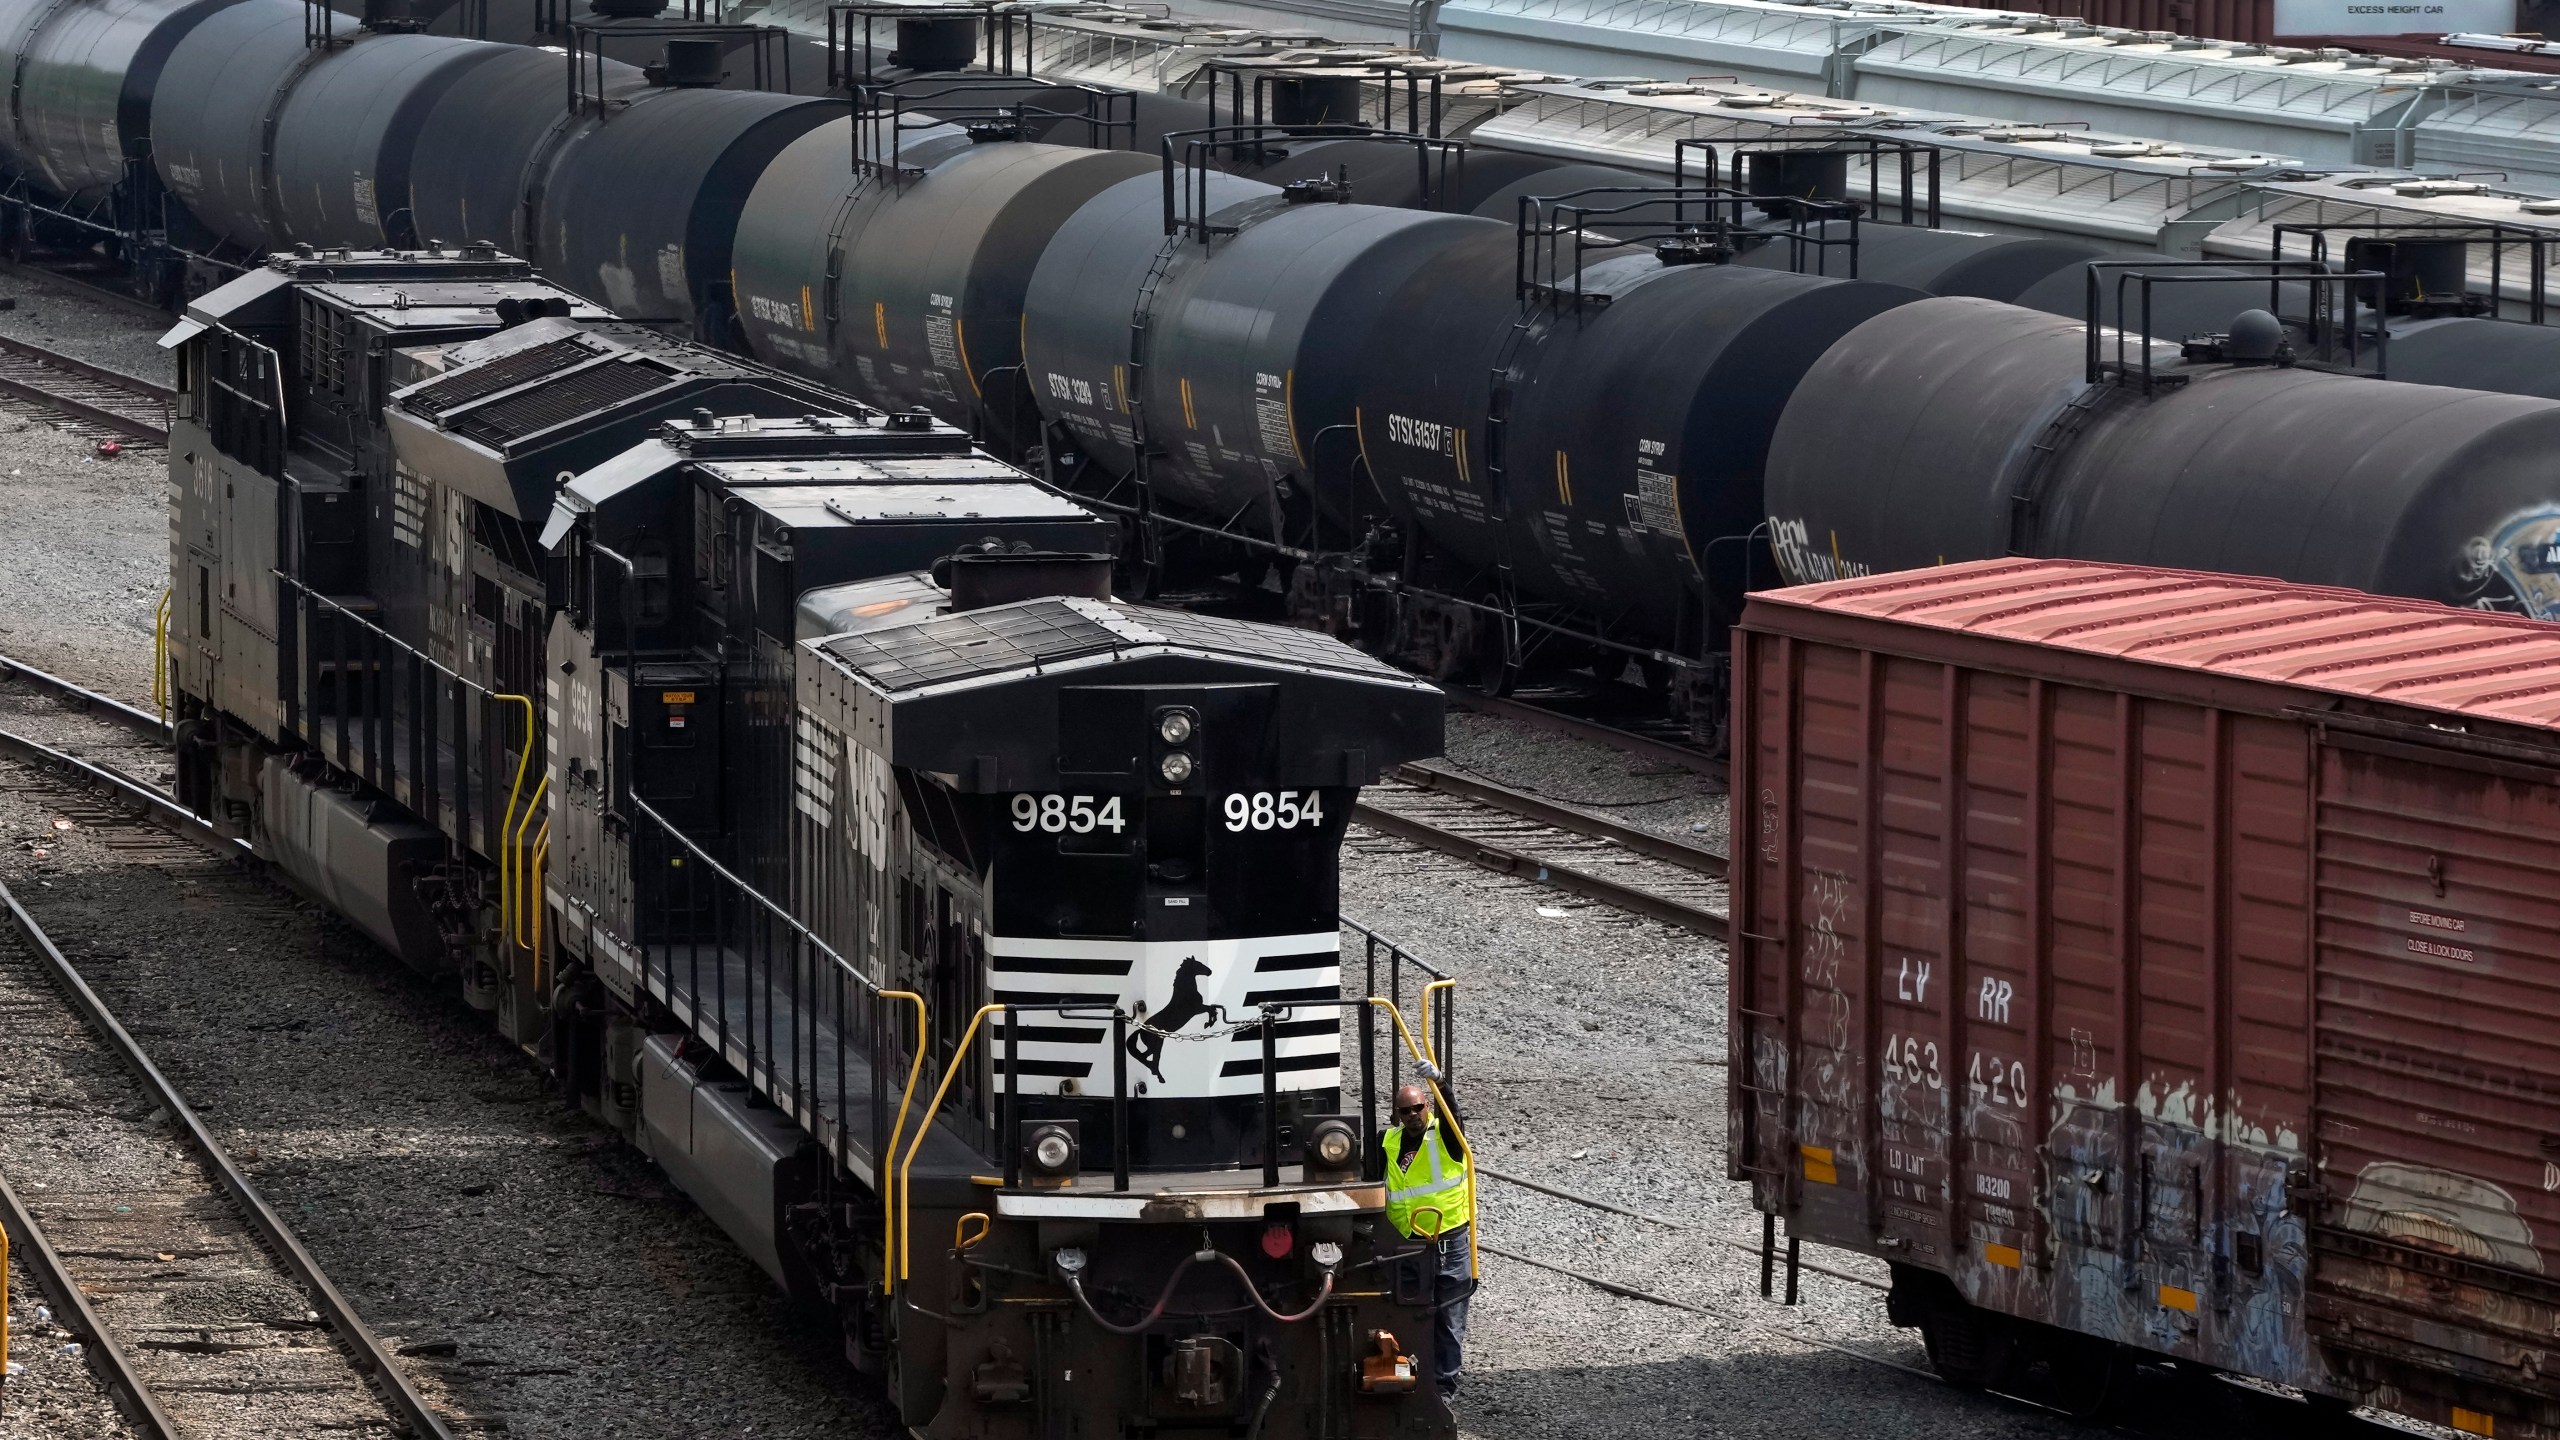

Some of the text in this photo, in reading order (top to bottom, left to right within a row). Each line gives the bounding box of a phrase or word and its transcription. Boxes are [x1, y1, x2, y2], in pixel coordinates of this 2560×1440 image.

[2347, 5, 2444, 14] EXCESS HEIGHT CAR
[1048, 372, 1073, 402] STSX
[1255, 372, 1268, 386] CORN
[1388, 413, 1441, 451] STSX 51537
[1639, 438, 1665, 456] CORN SYRUP
[572, 677, 593, 740] 9854
[1011, 793, 1126, 834] 9854
[1224, 790, 1324, 832] 9854
[2409, 911, 2465, 931] BEFORE MOVING CAR
[2408, 939, 2474, 962] CLOSE & LOCK DOORS
[1980, 976, 2012, 1024] RR
[1885, 1033, 2027, 1108] 463 420
[1889, 1148, 2010, 1200] LD LMT 183200
